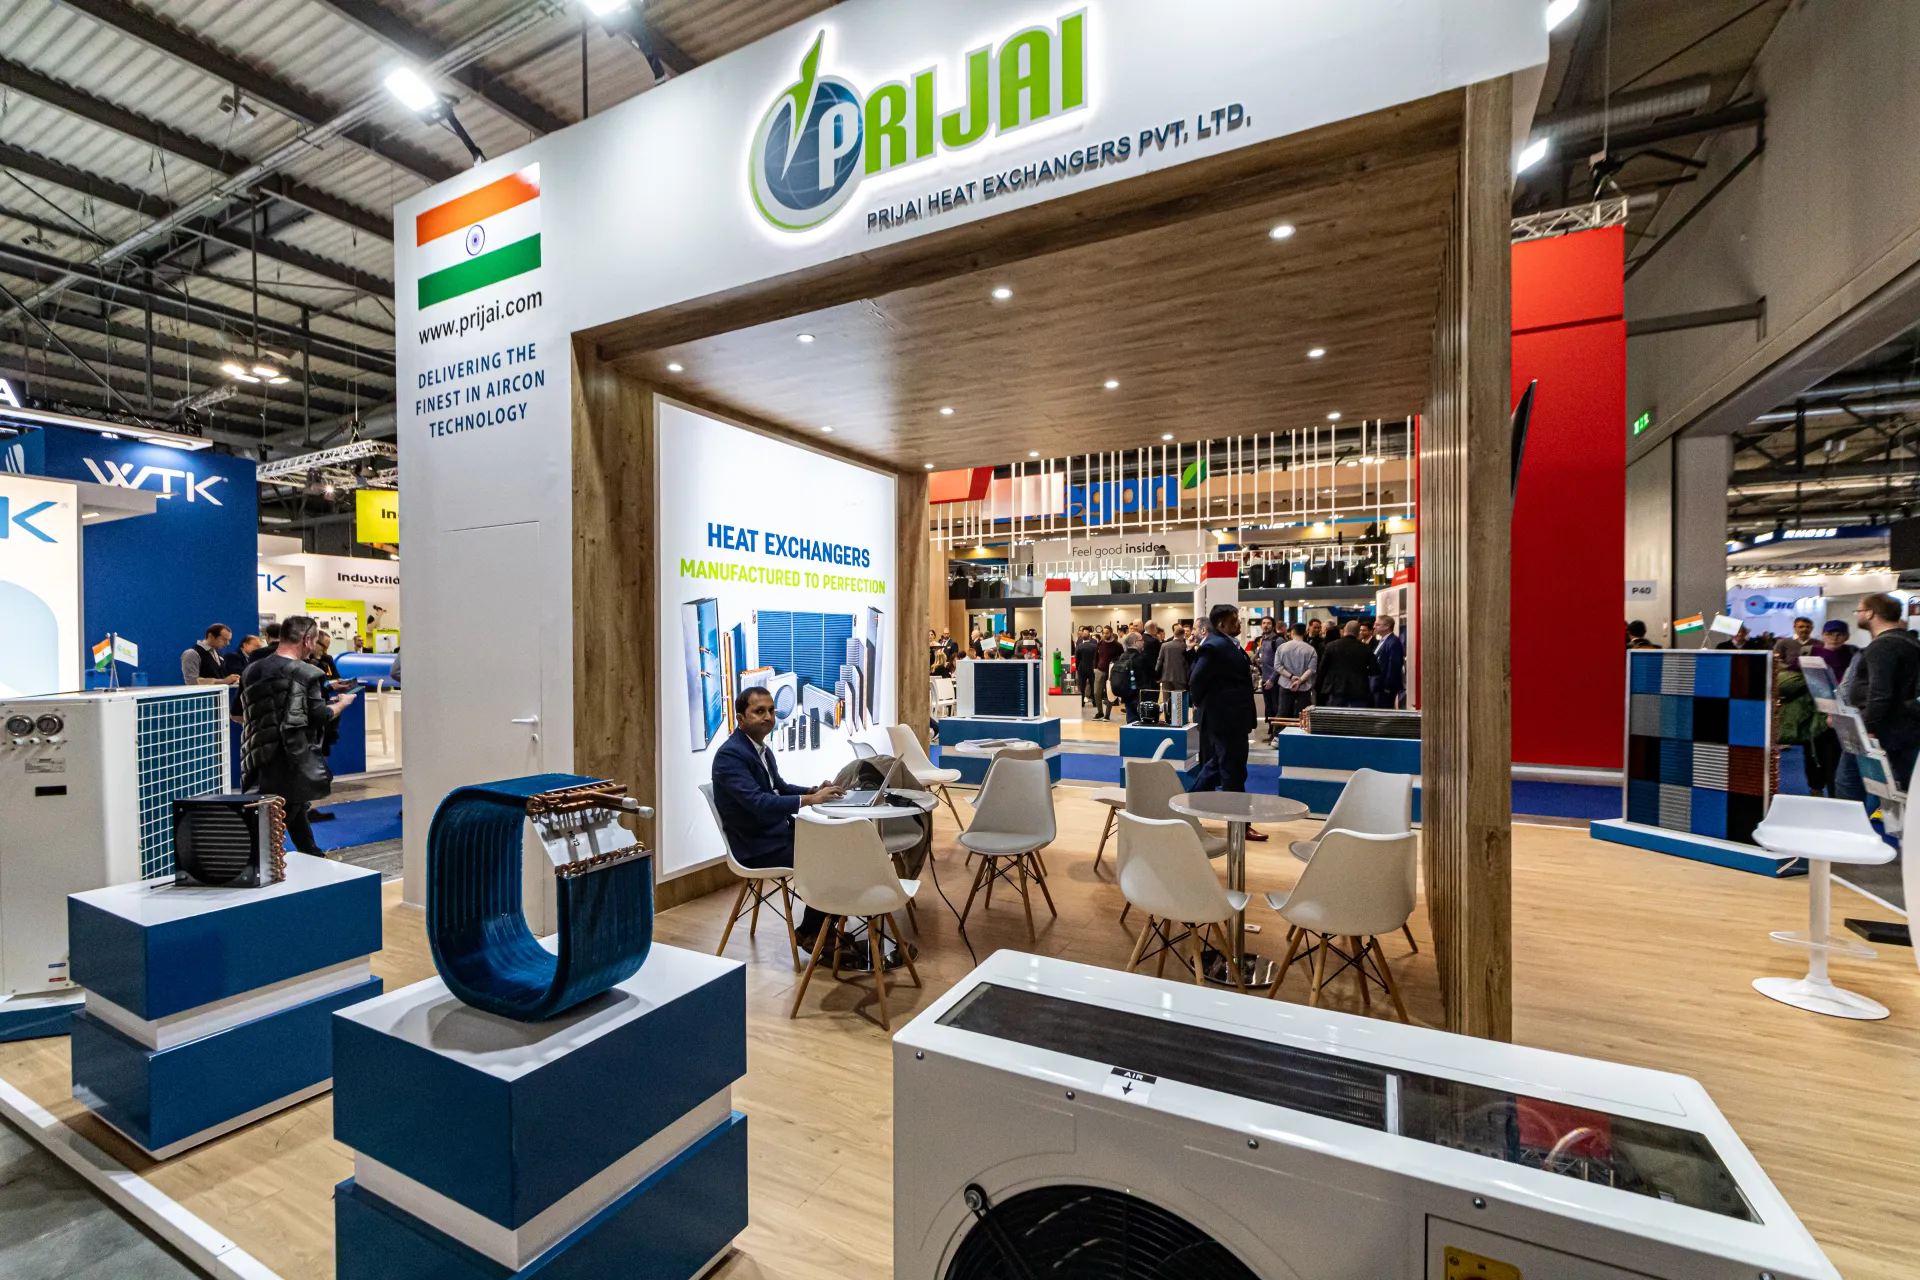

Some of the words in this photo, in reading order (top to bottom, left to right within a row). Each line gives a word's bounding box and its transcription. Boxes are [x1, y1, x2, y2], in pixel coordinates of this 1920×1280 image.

[818, 13, 1085, 191] PRIJAI
[867, 198, 923, 230] PRIJAI
[927, 182, 976, 211] HEAT
[982, 137, 1131, 194] EXCHANGERS
[1138, 120, 1188, 154] PVT.
[418, 291, 543, 345] www.prijai.com
[418, 352, 502, 390] DELIVERING
[507, 343, 536, 365] THE
[415, 390, 461, 416] FINEST
[465, 385, 482, 402] IN
[486, 369, 546, 399] AIRCON
[429, 402, 527, 439] TECHNOLOGY
[82, 457, 224, 506] WTK
[708, 522, 758, 553] HEAT
[765, 532, 870, 568] EXCHANGERS
[1072, 546, 1092, 557] Feel
[1095, 544, 1122, 558] good
[1125, 542, 1160, 553] inside
[680, 557, 801, 588] MANUFACTURED
[805, 573, 819, 589] TO
[823, 576, 886, 595] PERFECTION
[1123, 1071, 1144, 1081] AIR
